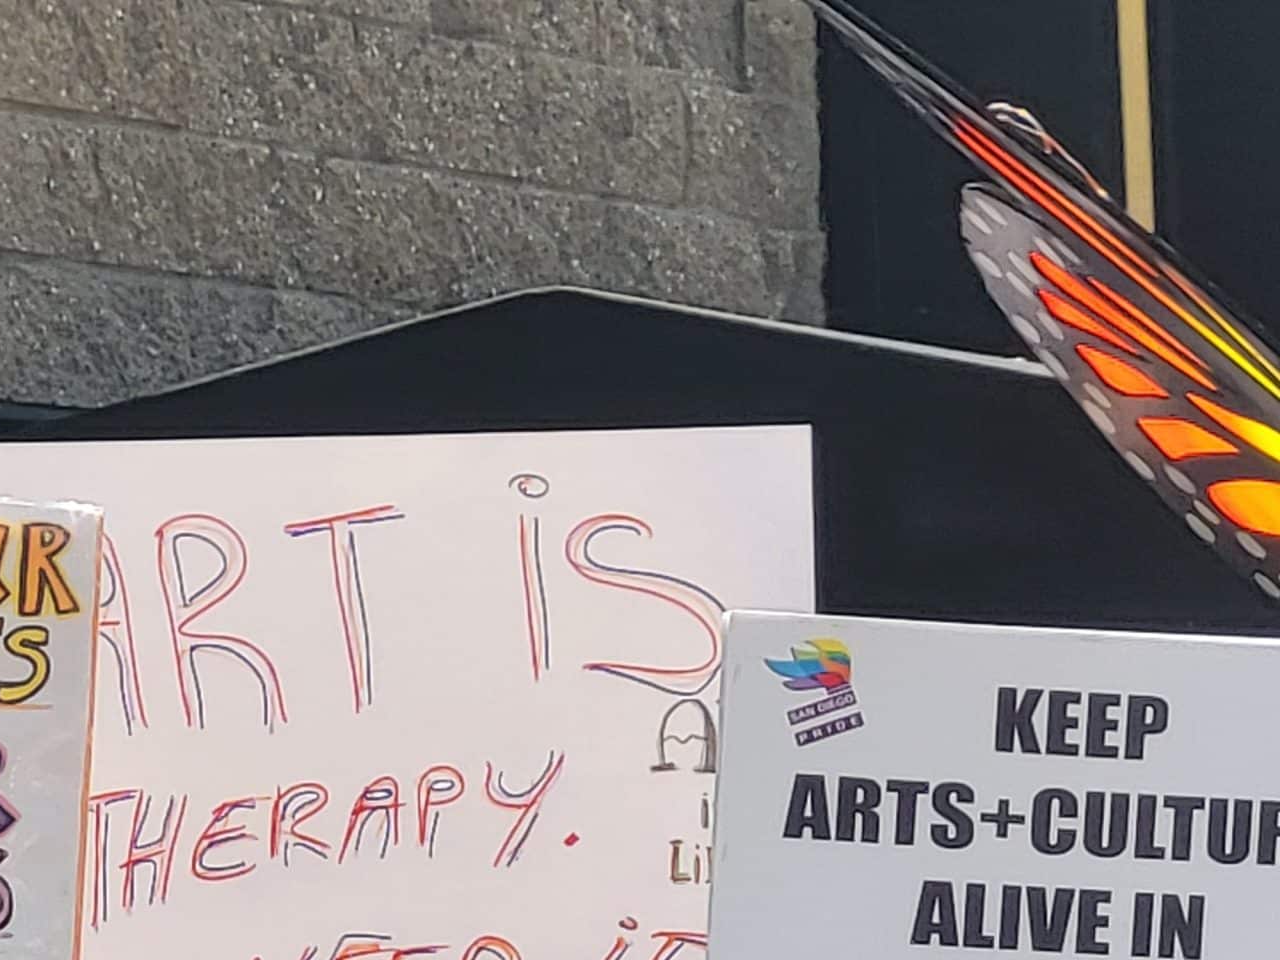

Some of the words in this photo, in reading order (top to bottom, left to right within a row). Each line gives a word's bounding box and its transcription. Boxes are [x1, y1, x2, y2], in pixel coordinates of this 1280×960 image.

[798, 714, 862, 745] PRIDE
[994, 687, 1168, 760] KEEP
[89, 751, 580, 931] THERAPY.
[910, 881, 1111, 955] ALIVE
[1131, 892, 1205, 960] IN
